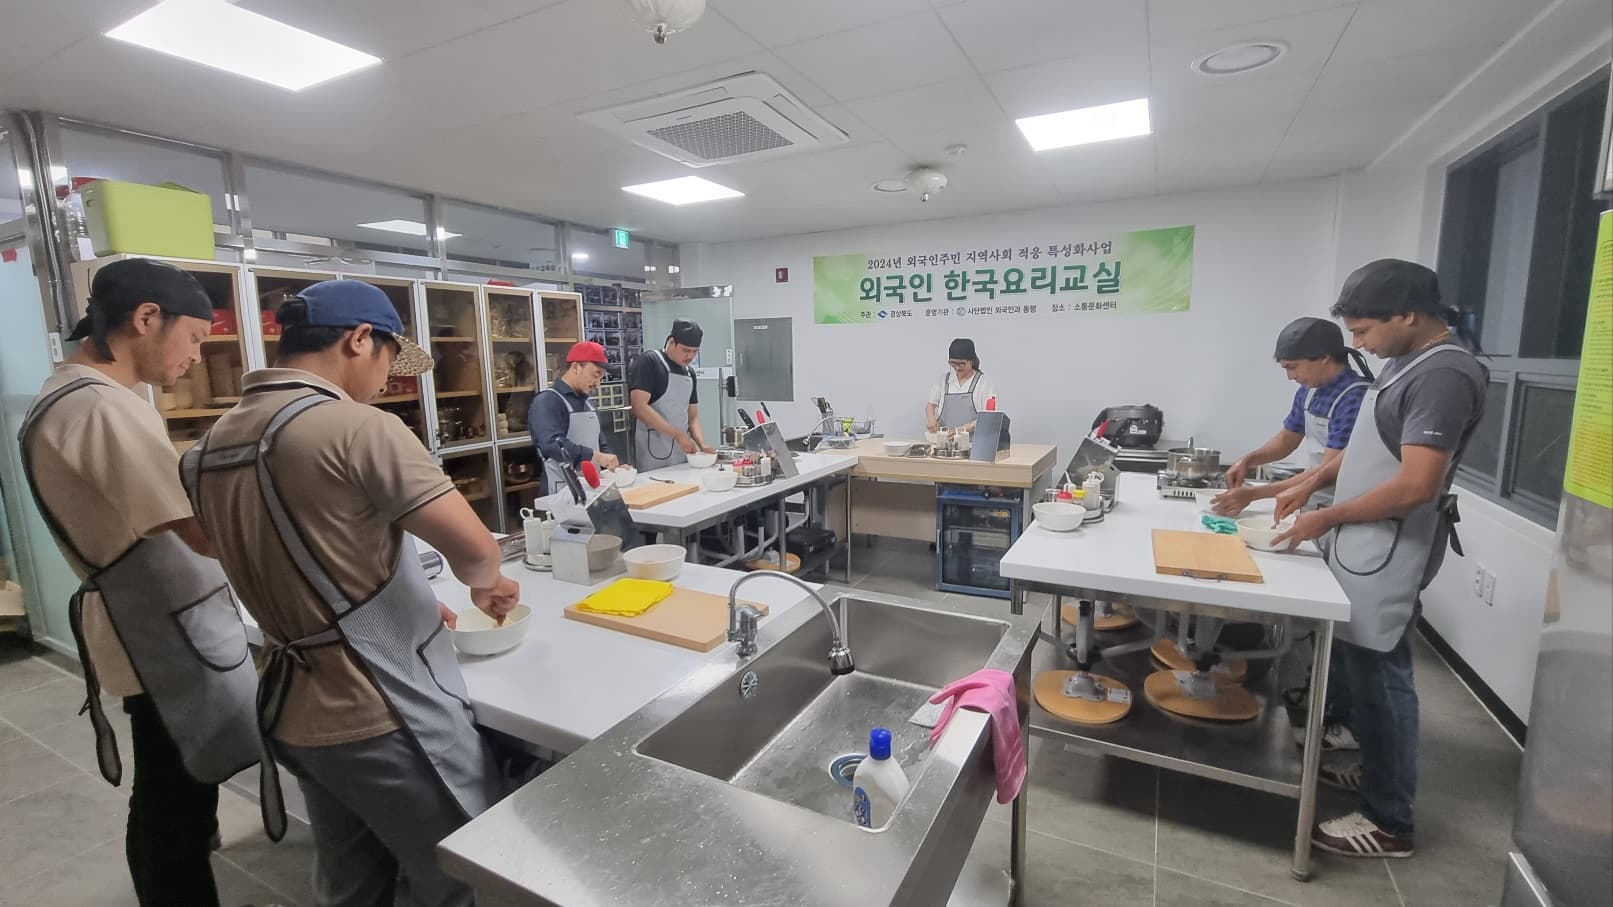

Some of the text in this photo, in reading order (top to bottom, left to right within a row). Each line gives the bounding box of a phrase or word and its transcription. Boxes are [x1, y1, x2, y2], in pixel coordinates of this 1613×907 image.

[867, 241, 1112, 269] 2024년 외국인주민 지역사회 적응 특성화사업
[859, 261, 1121, 304] 외국인 한국요리교실
[967, 306, 993, 316] 사단법인
[995, 305, 1020, 314] 외국인과
[1051, 304, 1065, 313] 장소
[1073, 301, 1117, 312] 소통문화센터
